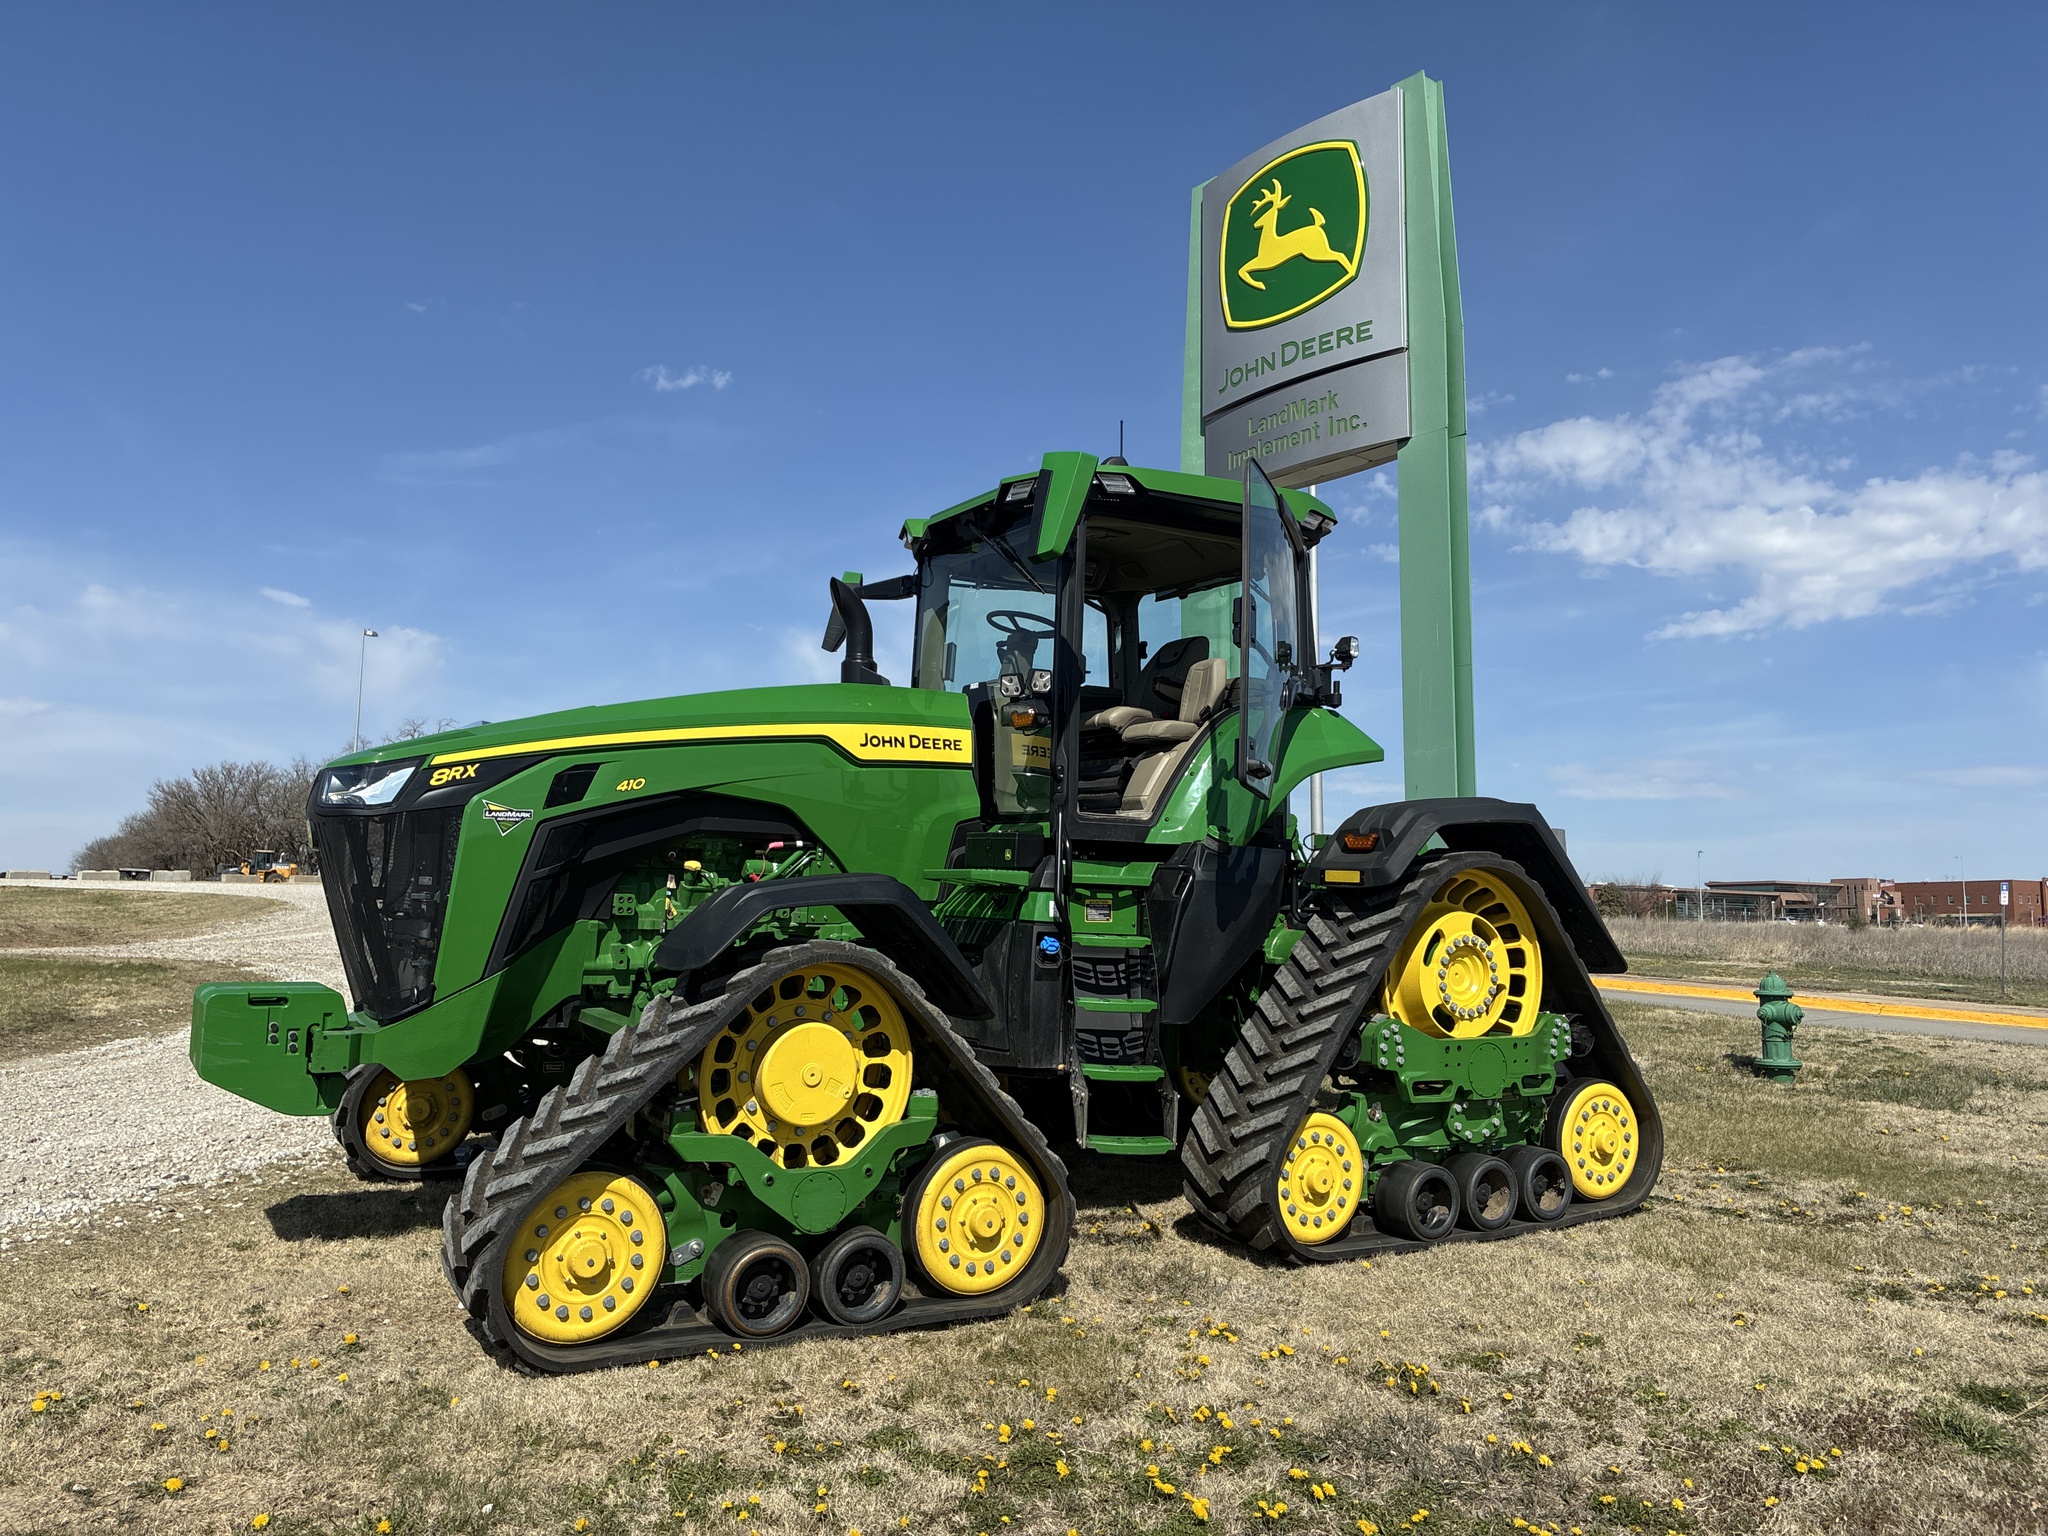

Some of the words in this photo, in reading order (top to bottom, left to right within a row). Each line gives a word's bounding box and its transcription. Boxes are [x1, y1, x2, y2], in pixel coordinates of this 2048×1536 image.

[1218, 351, 1276, 395] JOHN
[1281, 319, 1373, 367] DEERE
[1248, 390, 1339, 437] LandMark
[1328, 414, 1367, 437] Inc.
[860, 733, 905, 748] JOHN
[909, 734, 963, 751] DEERE
[430, 763, 480, 786] 8RX
[615, 777, 646, 792] 410
